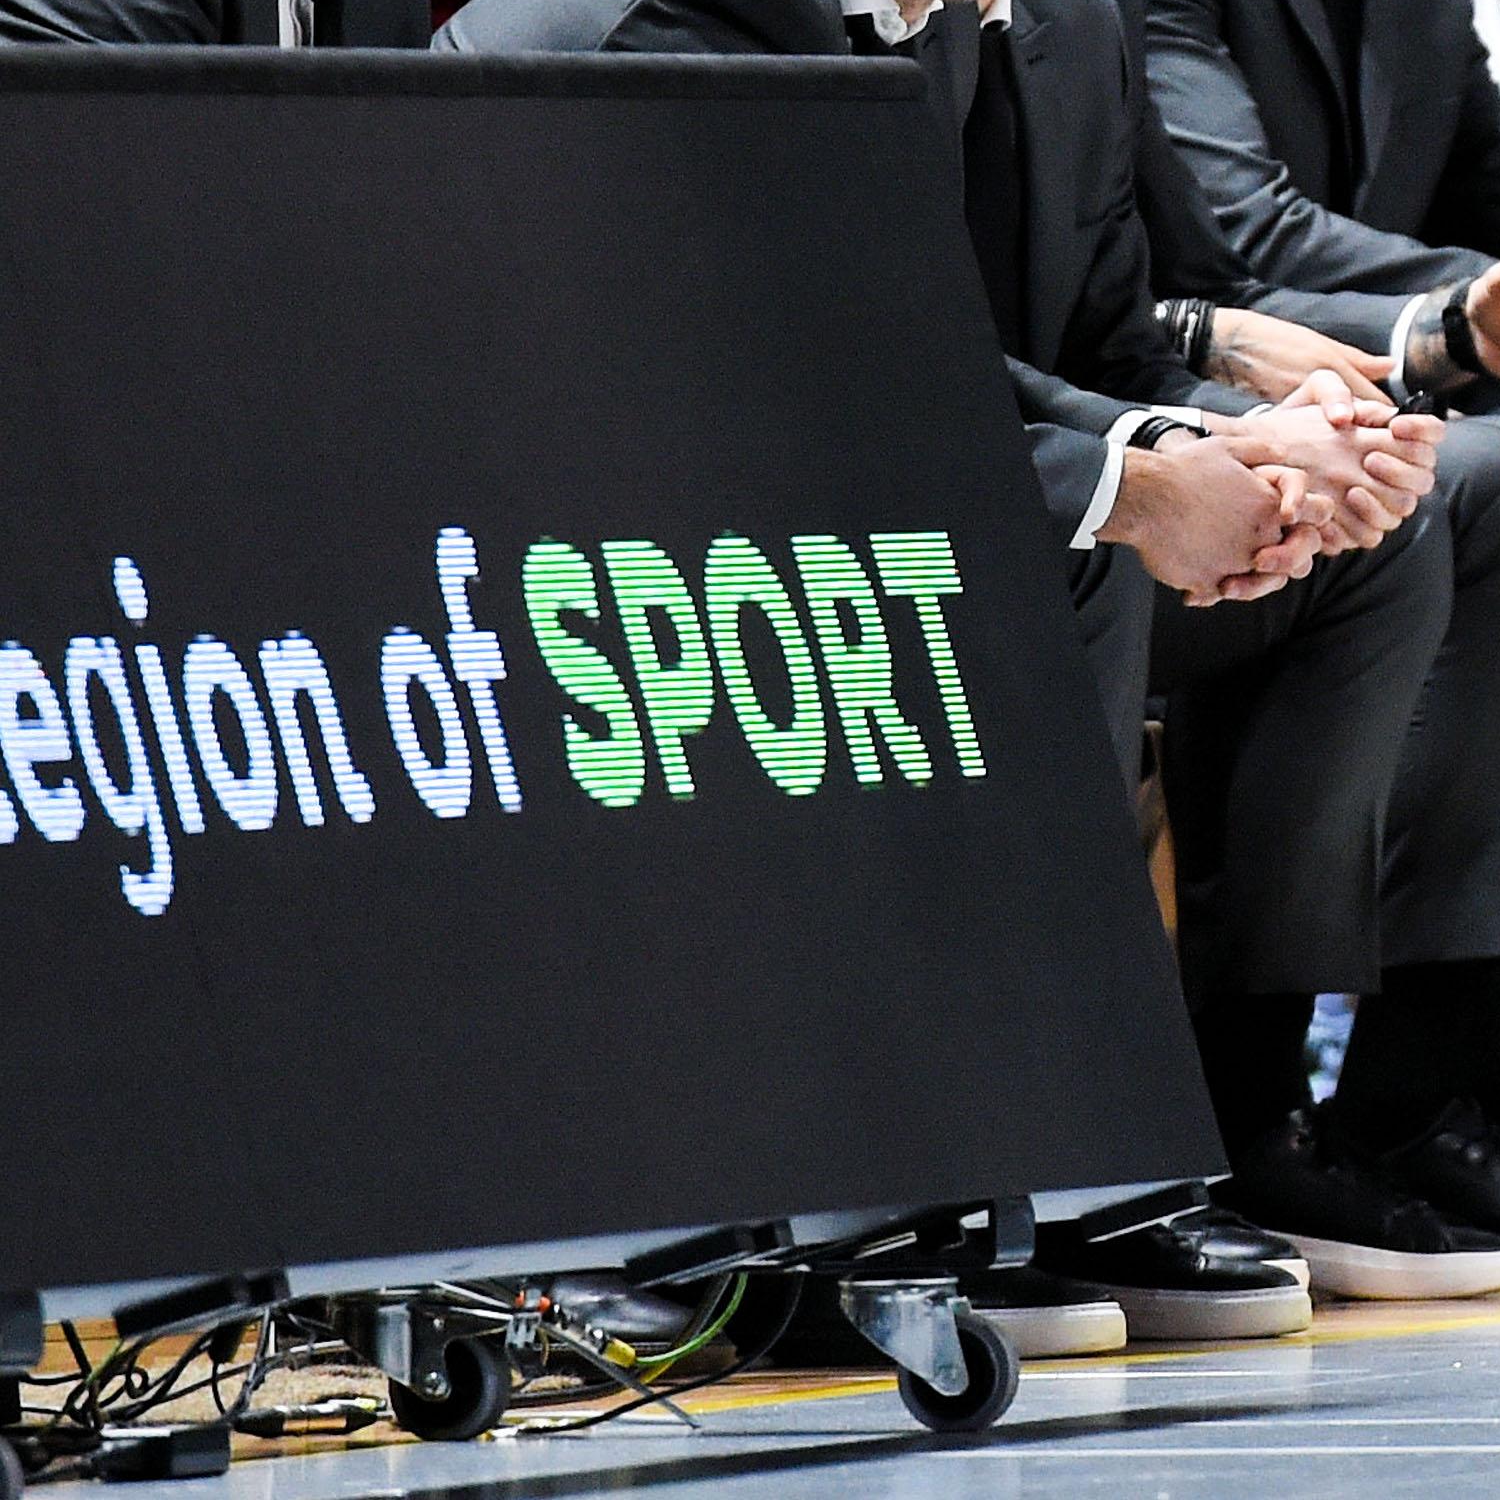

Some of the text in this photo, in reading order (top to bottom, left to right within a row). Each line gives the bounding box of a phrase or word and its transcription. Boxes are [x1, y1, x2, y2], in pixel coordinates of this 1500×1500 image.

[0, 526, 988, 918] egion of SPORT
